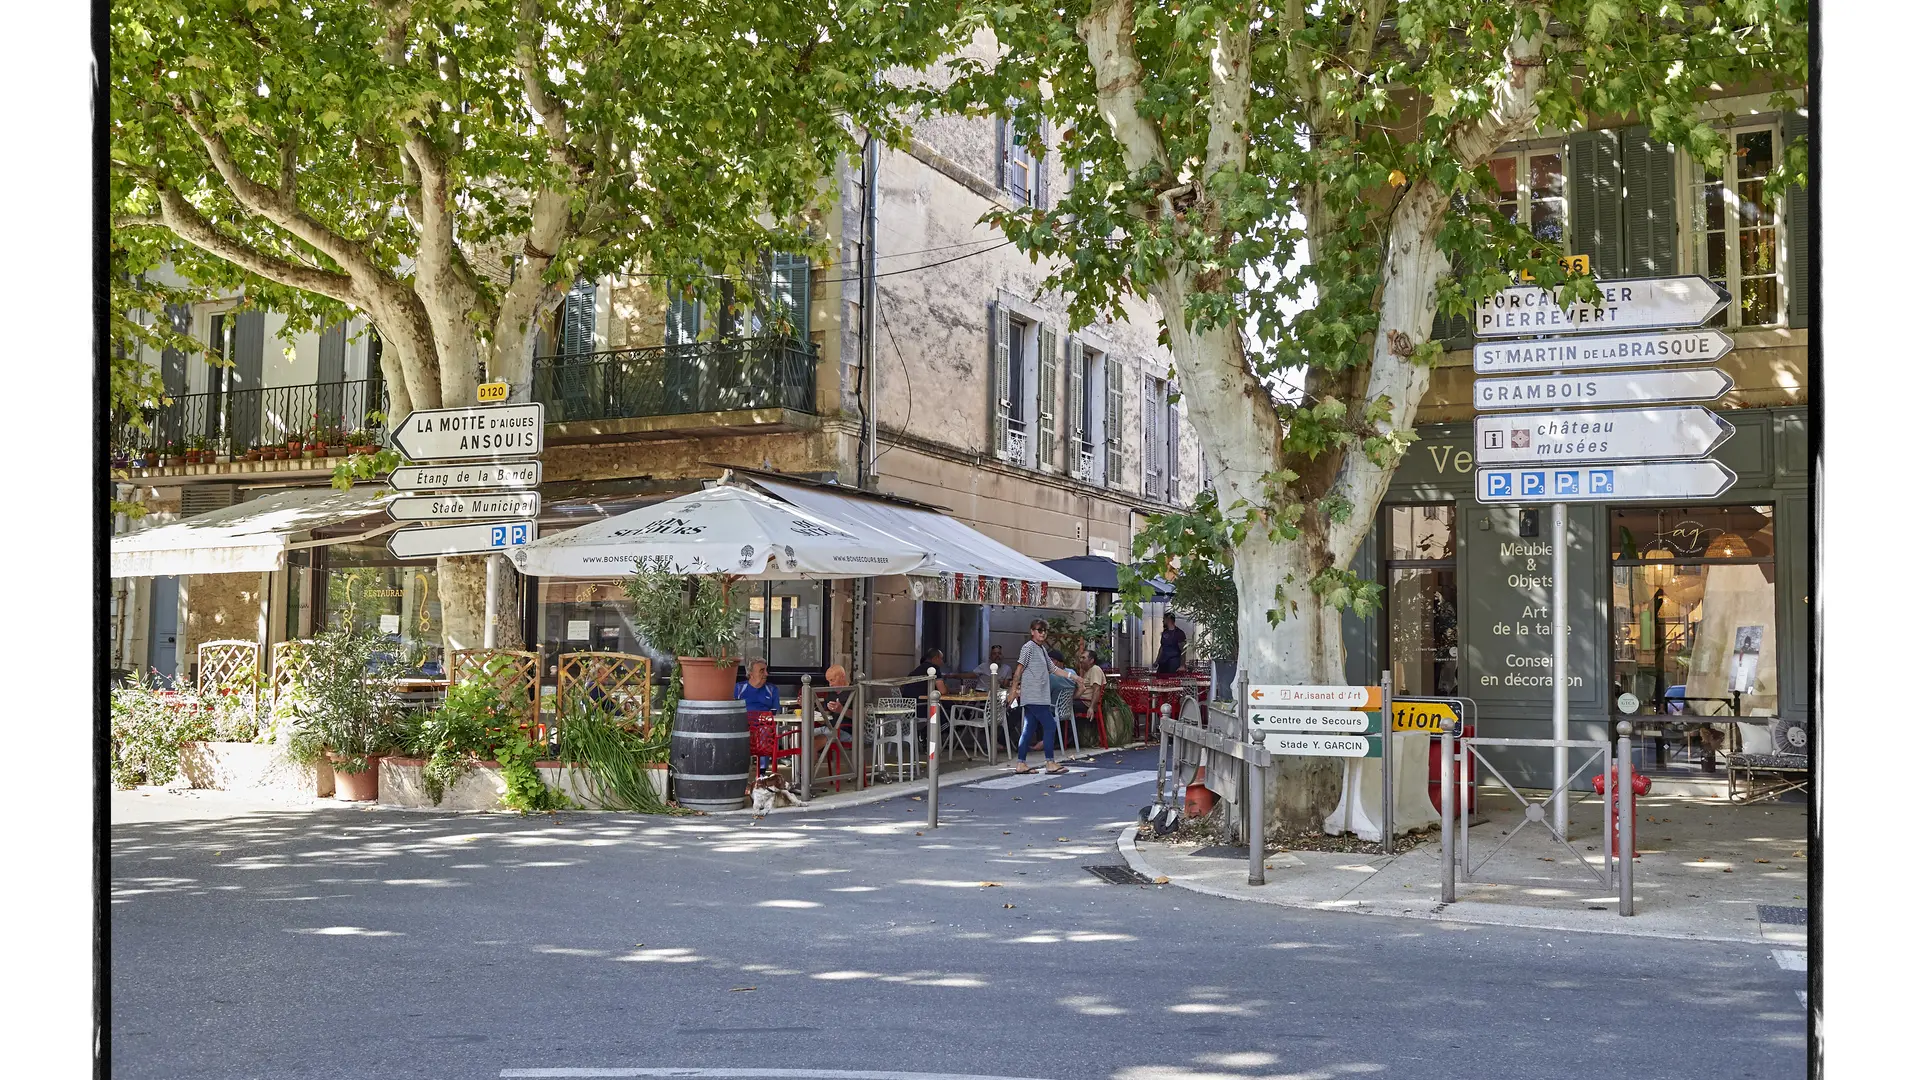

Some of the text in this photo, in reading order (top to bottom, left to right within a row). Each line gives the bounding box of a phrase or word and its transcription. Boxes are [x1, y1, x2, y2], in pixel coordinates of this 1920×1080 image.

[1483, 307, 1618, 328] PIERREVERT
[1507, 346, 1577, 364] MARTIN
[1584, 349, 1598, 359] DE
[1602, 348, 1616, 358] LA
[1618, 338, 1710, 358] BRASQUE
[480, 387, 504, 397] D120
[1483, 381, 1597, 400] GRAMBOIS
[417, 419, 433, 433] LA
[440, 415, 485, 432] MOTTE
[1537, 421, 1613, 436] château
[460, 432, 533, 450] ANSOUIS
[1536, 439, 1609, 455] musées
[417, 470, 449, 486] Étang
[457, 470, 469, 482] de
[478, 470, 488, 482] la
[432, 500, 533, 514] Stade Municipal
[1526, 558, 1537, 571] &
[1522, 605, 1548, 618] Art
[1493, 621, 1572, 635] de la tae
[1481, 672, 1583, 687] en décoraon
[1294, 691, 1335, 700] Arisanat
[1269, 715, 1362, 725] Centre de Secours
[1391, 707, 1442, 728] tion
[1280, 740, 1308, 749] Stade
[1324, 741, 1362, 750] GARCIN
